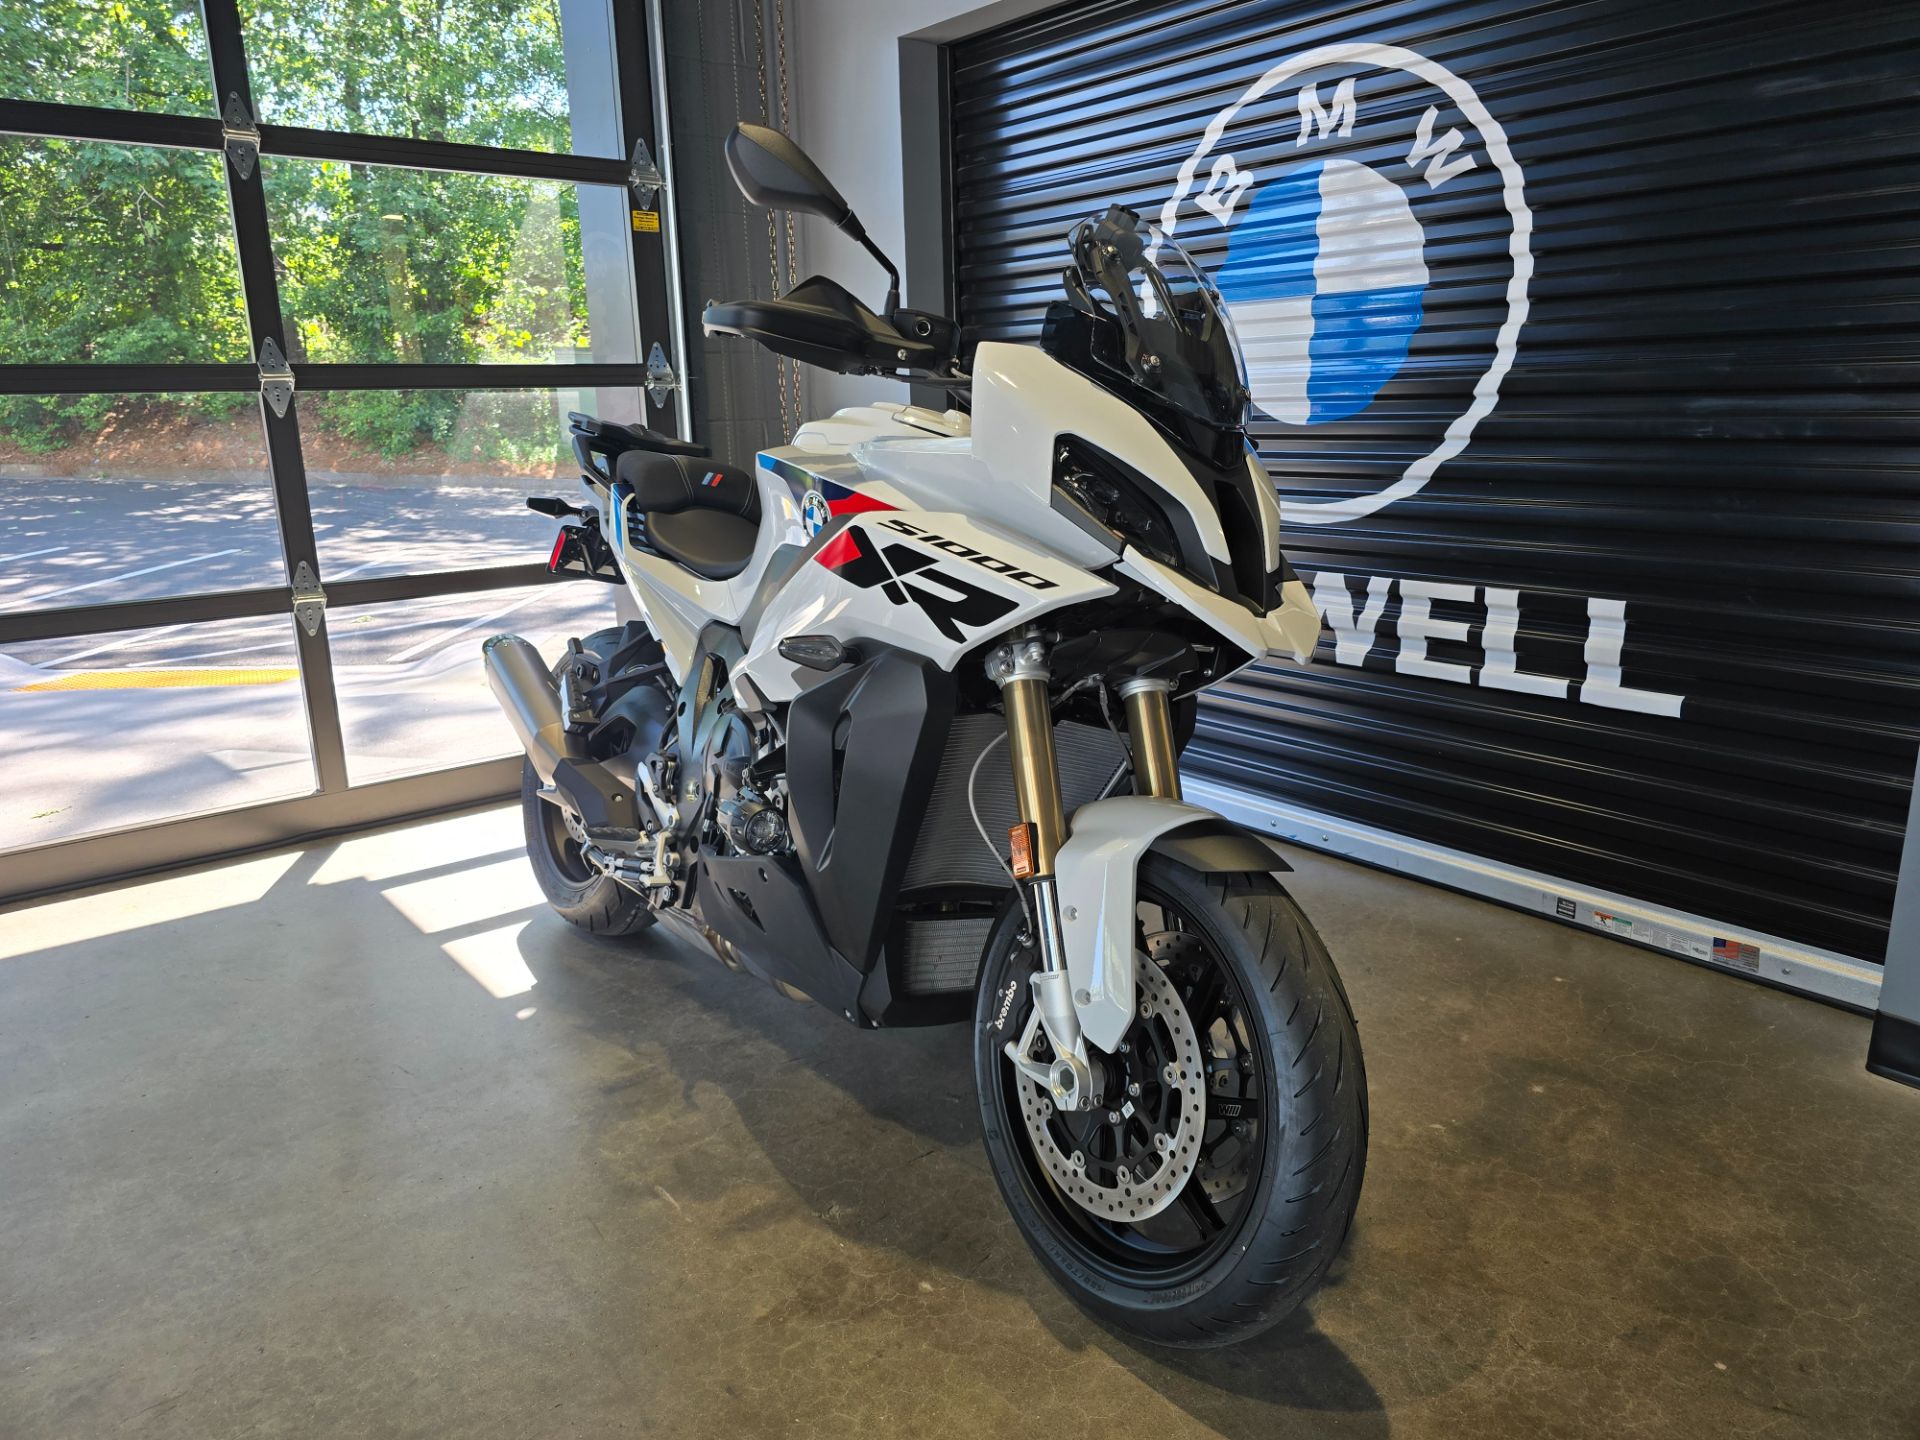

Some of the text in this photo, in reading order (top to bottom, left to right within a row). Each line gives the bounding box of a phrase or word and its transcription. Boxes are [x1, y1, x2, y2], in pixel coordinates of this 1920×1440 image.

[1194, 77, 1478, 227] BMW
[876, 519, 1060, 590] S1000
[994, 980, 1017, 1031] brembo
